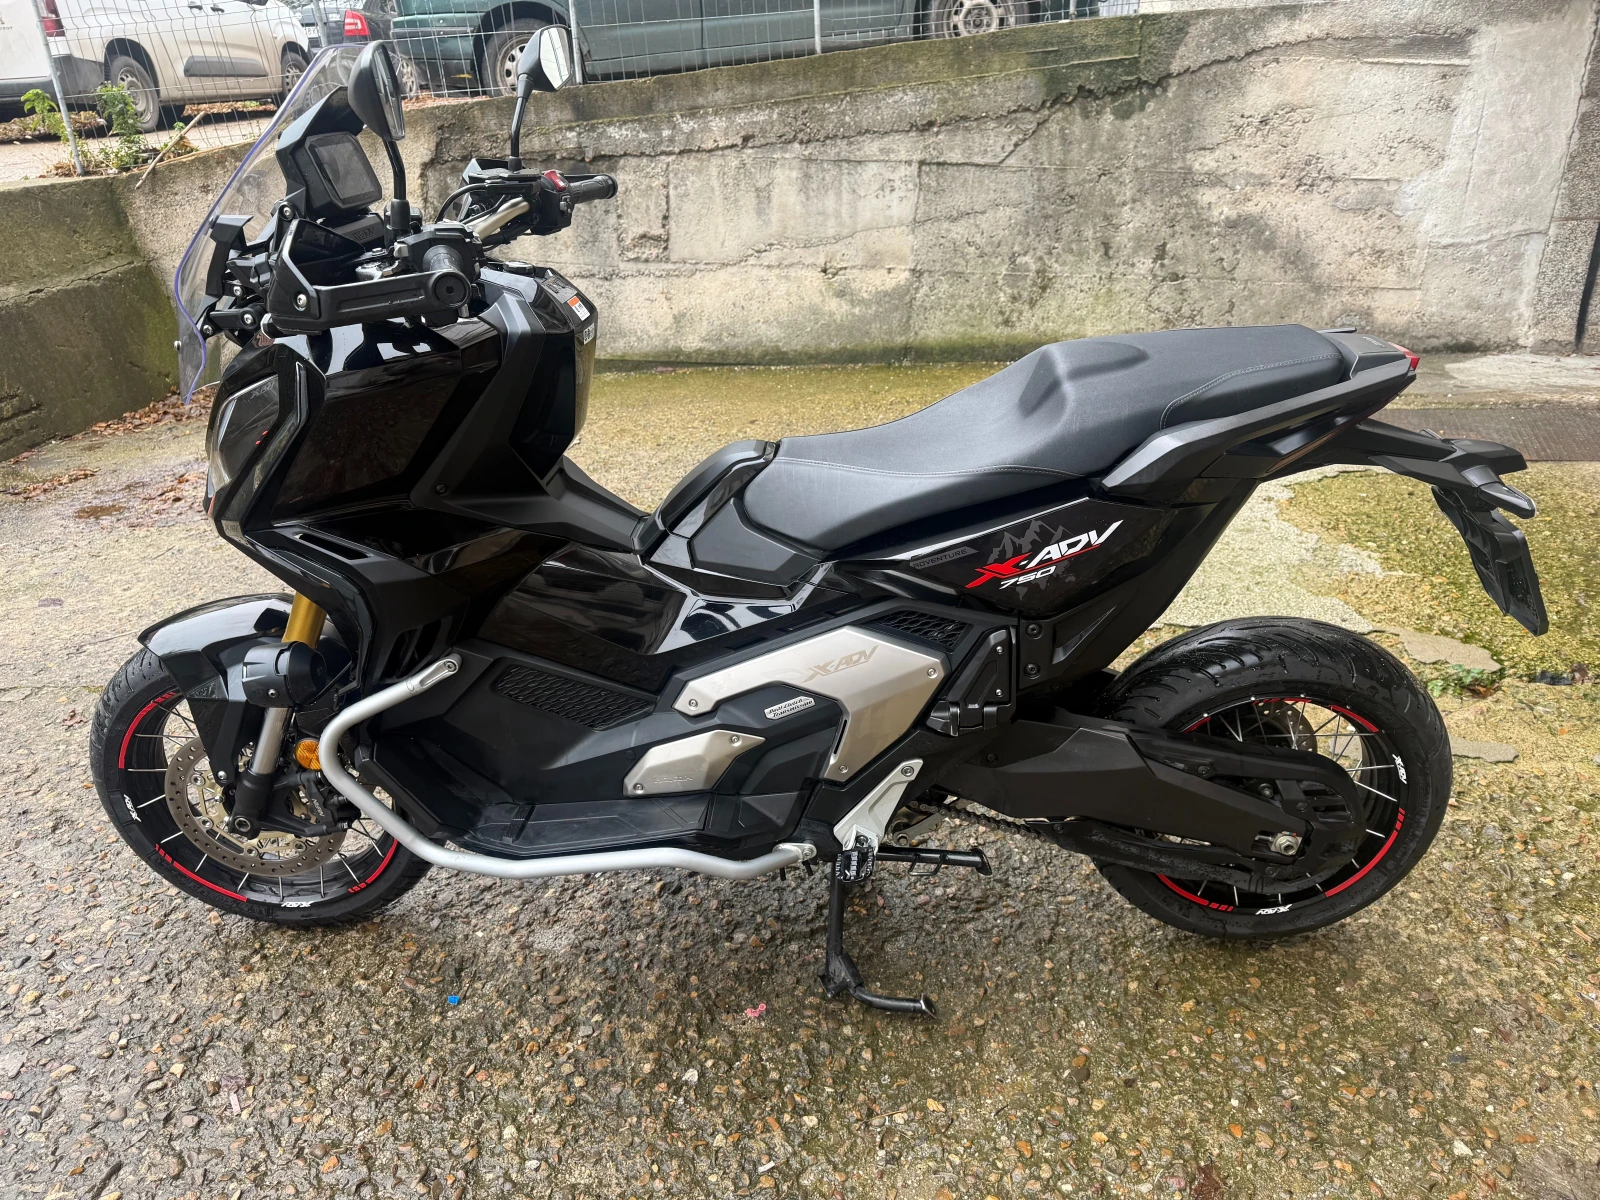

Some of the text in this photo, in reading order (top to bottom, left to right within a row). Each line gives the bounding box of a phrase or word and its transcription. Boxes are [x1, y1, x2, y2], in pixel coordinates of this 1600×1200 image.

[912, 548, 968, 568] ADVENTURE
[965, 519, 1124, 589] X-ADV
[999, 565, 1057, 590] 750
[802, 645, 879, 683] X-ADV
